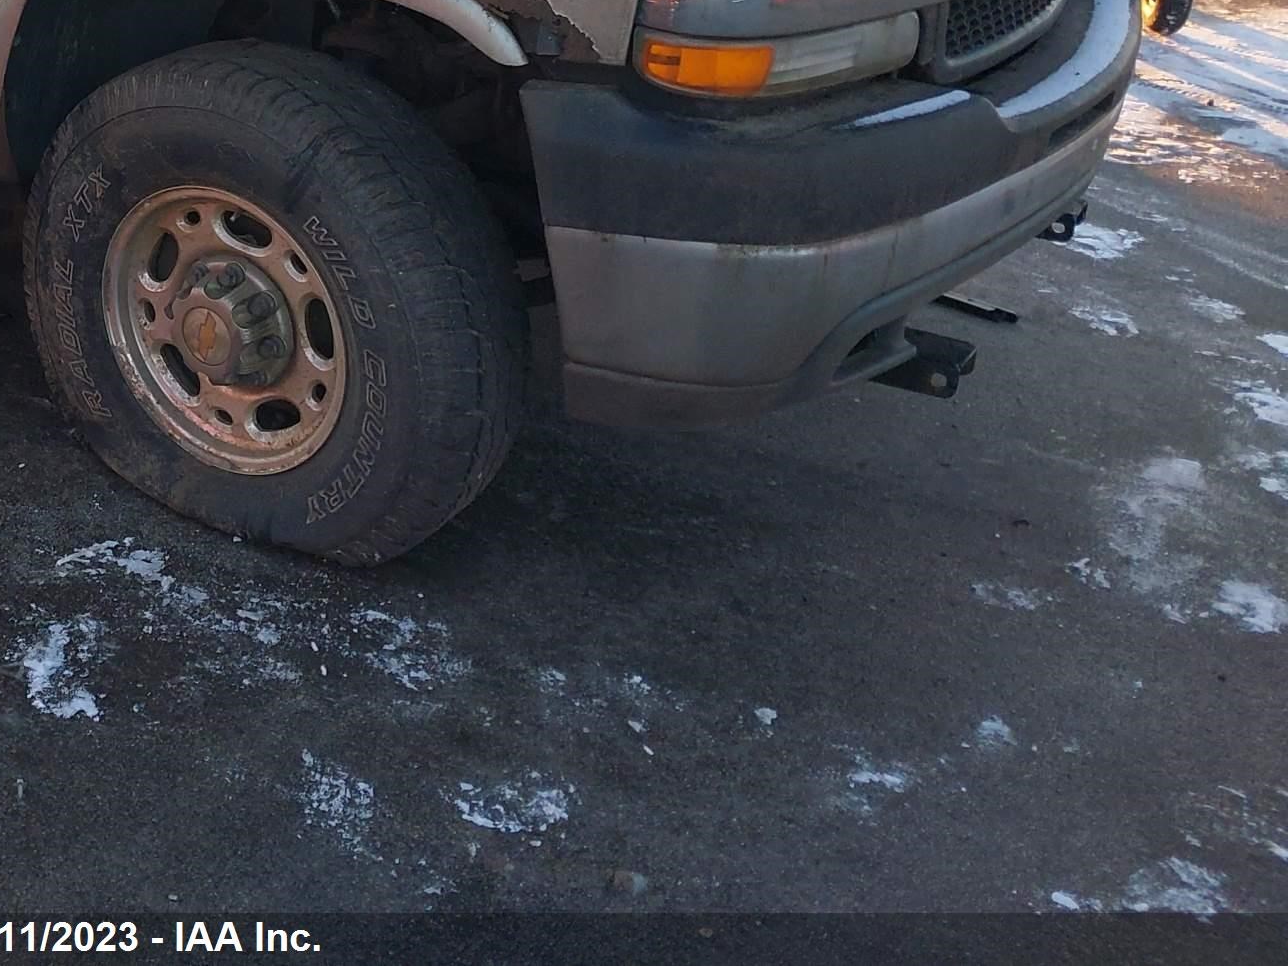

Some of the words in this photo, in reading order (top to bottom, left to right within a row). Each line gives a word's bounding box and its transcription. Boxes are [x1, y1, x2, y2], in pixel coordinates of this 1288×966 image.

[62, 162, 111, 243] XTX
[53, 257, 113, 418] RADIAL
[303, 215, 377, 330] WILD
[305, 348, 387, 525] COUNTRY
